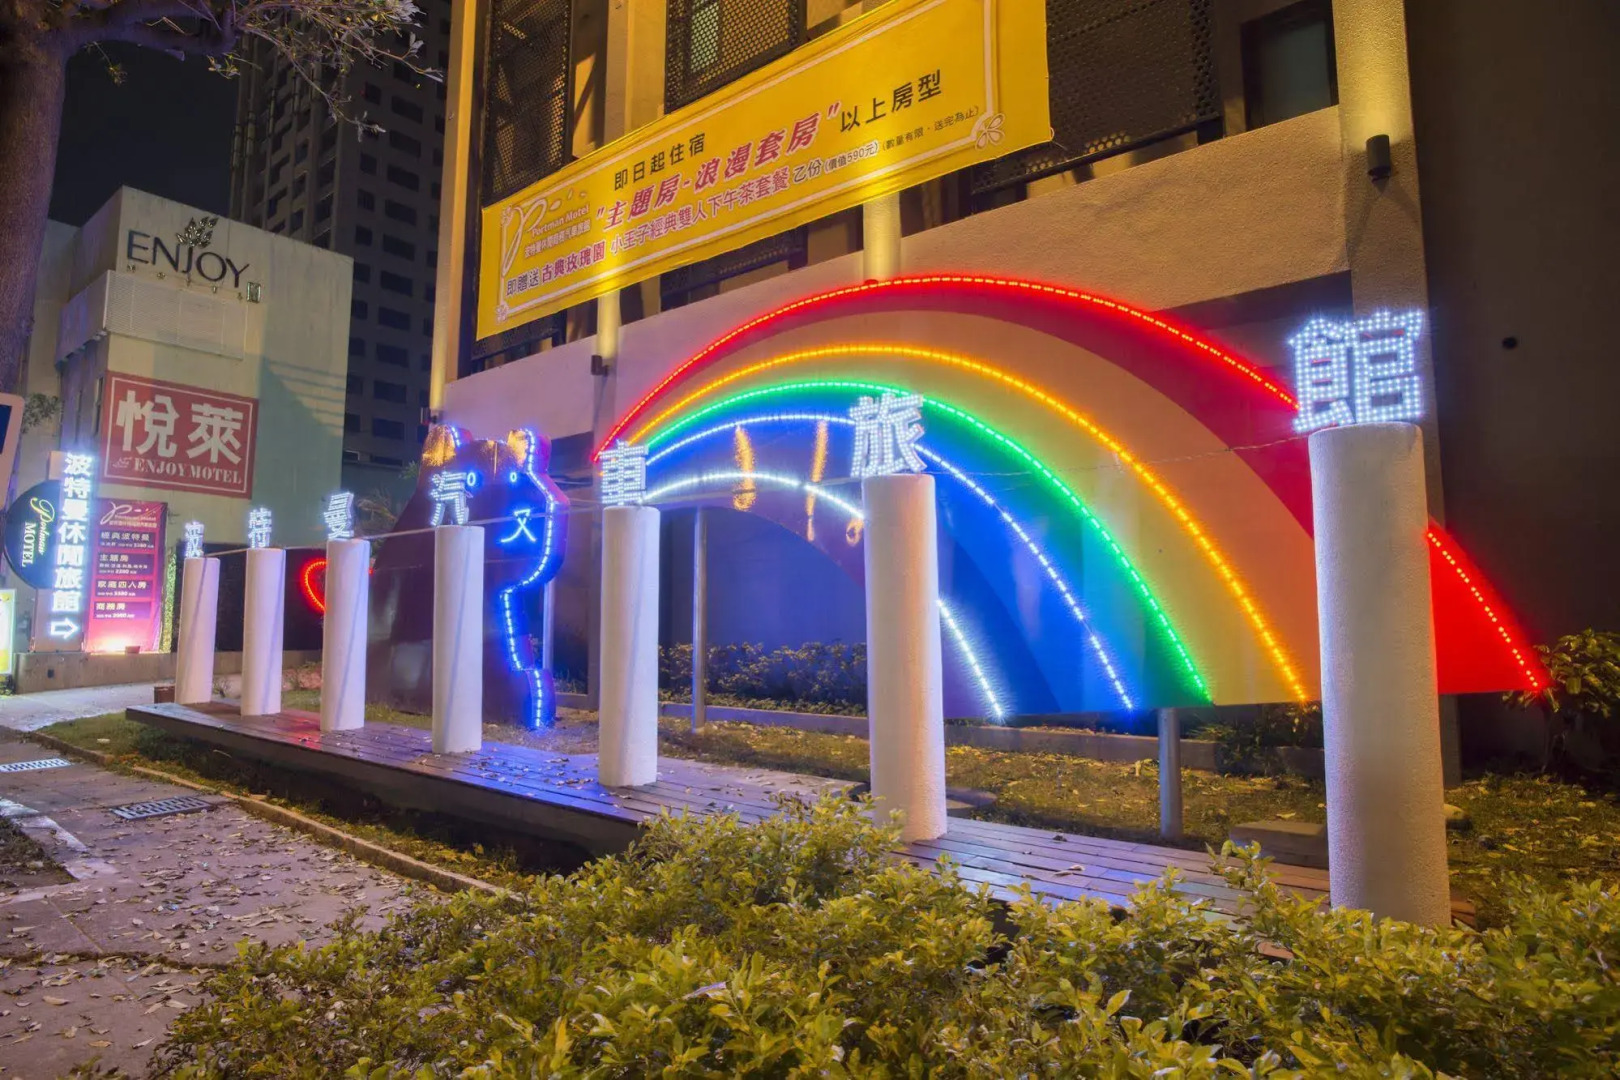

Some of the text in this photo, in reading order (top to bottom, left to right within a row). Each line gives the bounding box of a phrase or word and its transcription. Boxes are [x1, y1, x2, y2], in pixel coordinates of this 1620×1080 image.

[842, 69, 942, 133] 以上房型
[613, 133, 706, 190] 即日起住宿
[506, 268, 540, 296] 即贈送
[541, 240, 606, 283] 古典玫瑰園
[610, 167, 791, 255] 小王子經典雙人下午茶套餐
[792, 159, 822, 181] 乙份
[532, 204, 590, 238] Portman Motel
[127, 229, 251, 288] ENJOY
[116, 389, 244, 465] 悅萊
[247, 507, 273, 548] 特
[325, 491, 355, 540] 曼
[601, 439, 649, 505] 車
[849, 392, 928, 478] 旅
[1288, 308, 1426, 433] 館
[134, 457, 243, 485] ENJOY MOTEL
[22, 521, 36, 568] MOTEL
